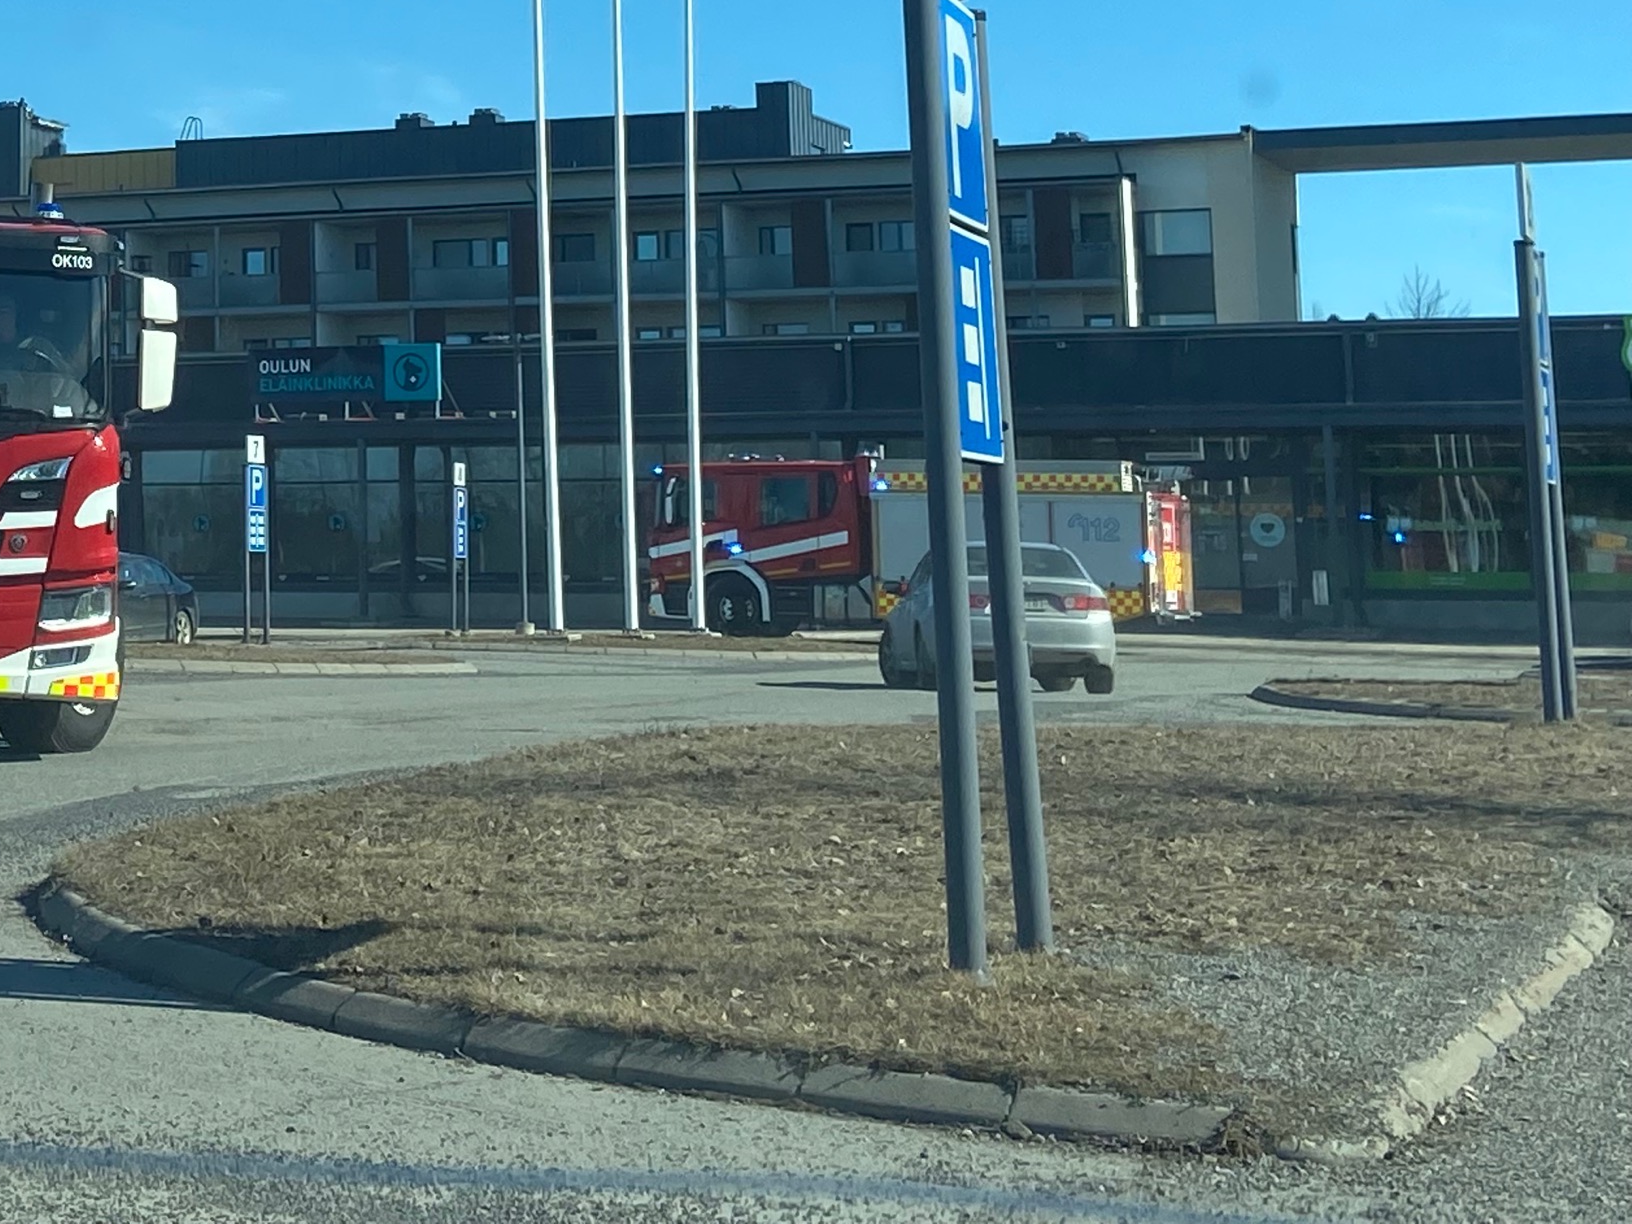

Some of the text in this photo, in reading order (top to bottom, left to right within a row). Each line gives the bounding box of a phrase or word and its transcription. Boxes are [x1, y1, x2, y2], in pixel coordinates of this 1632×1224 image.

[945, 13, 973, 200] P
[51, 253, 93, 269] OK103
[259, 358, 311, 374] OULUN
[259, 375, 375, 393] ELÄINKLINIKKA
[252, 440, 259, 459] 7
[251, 468, 263, 504] P
[1081, 515, 1121, 543] 112
